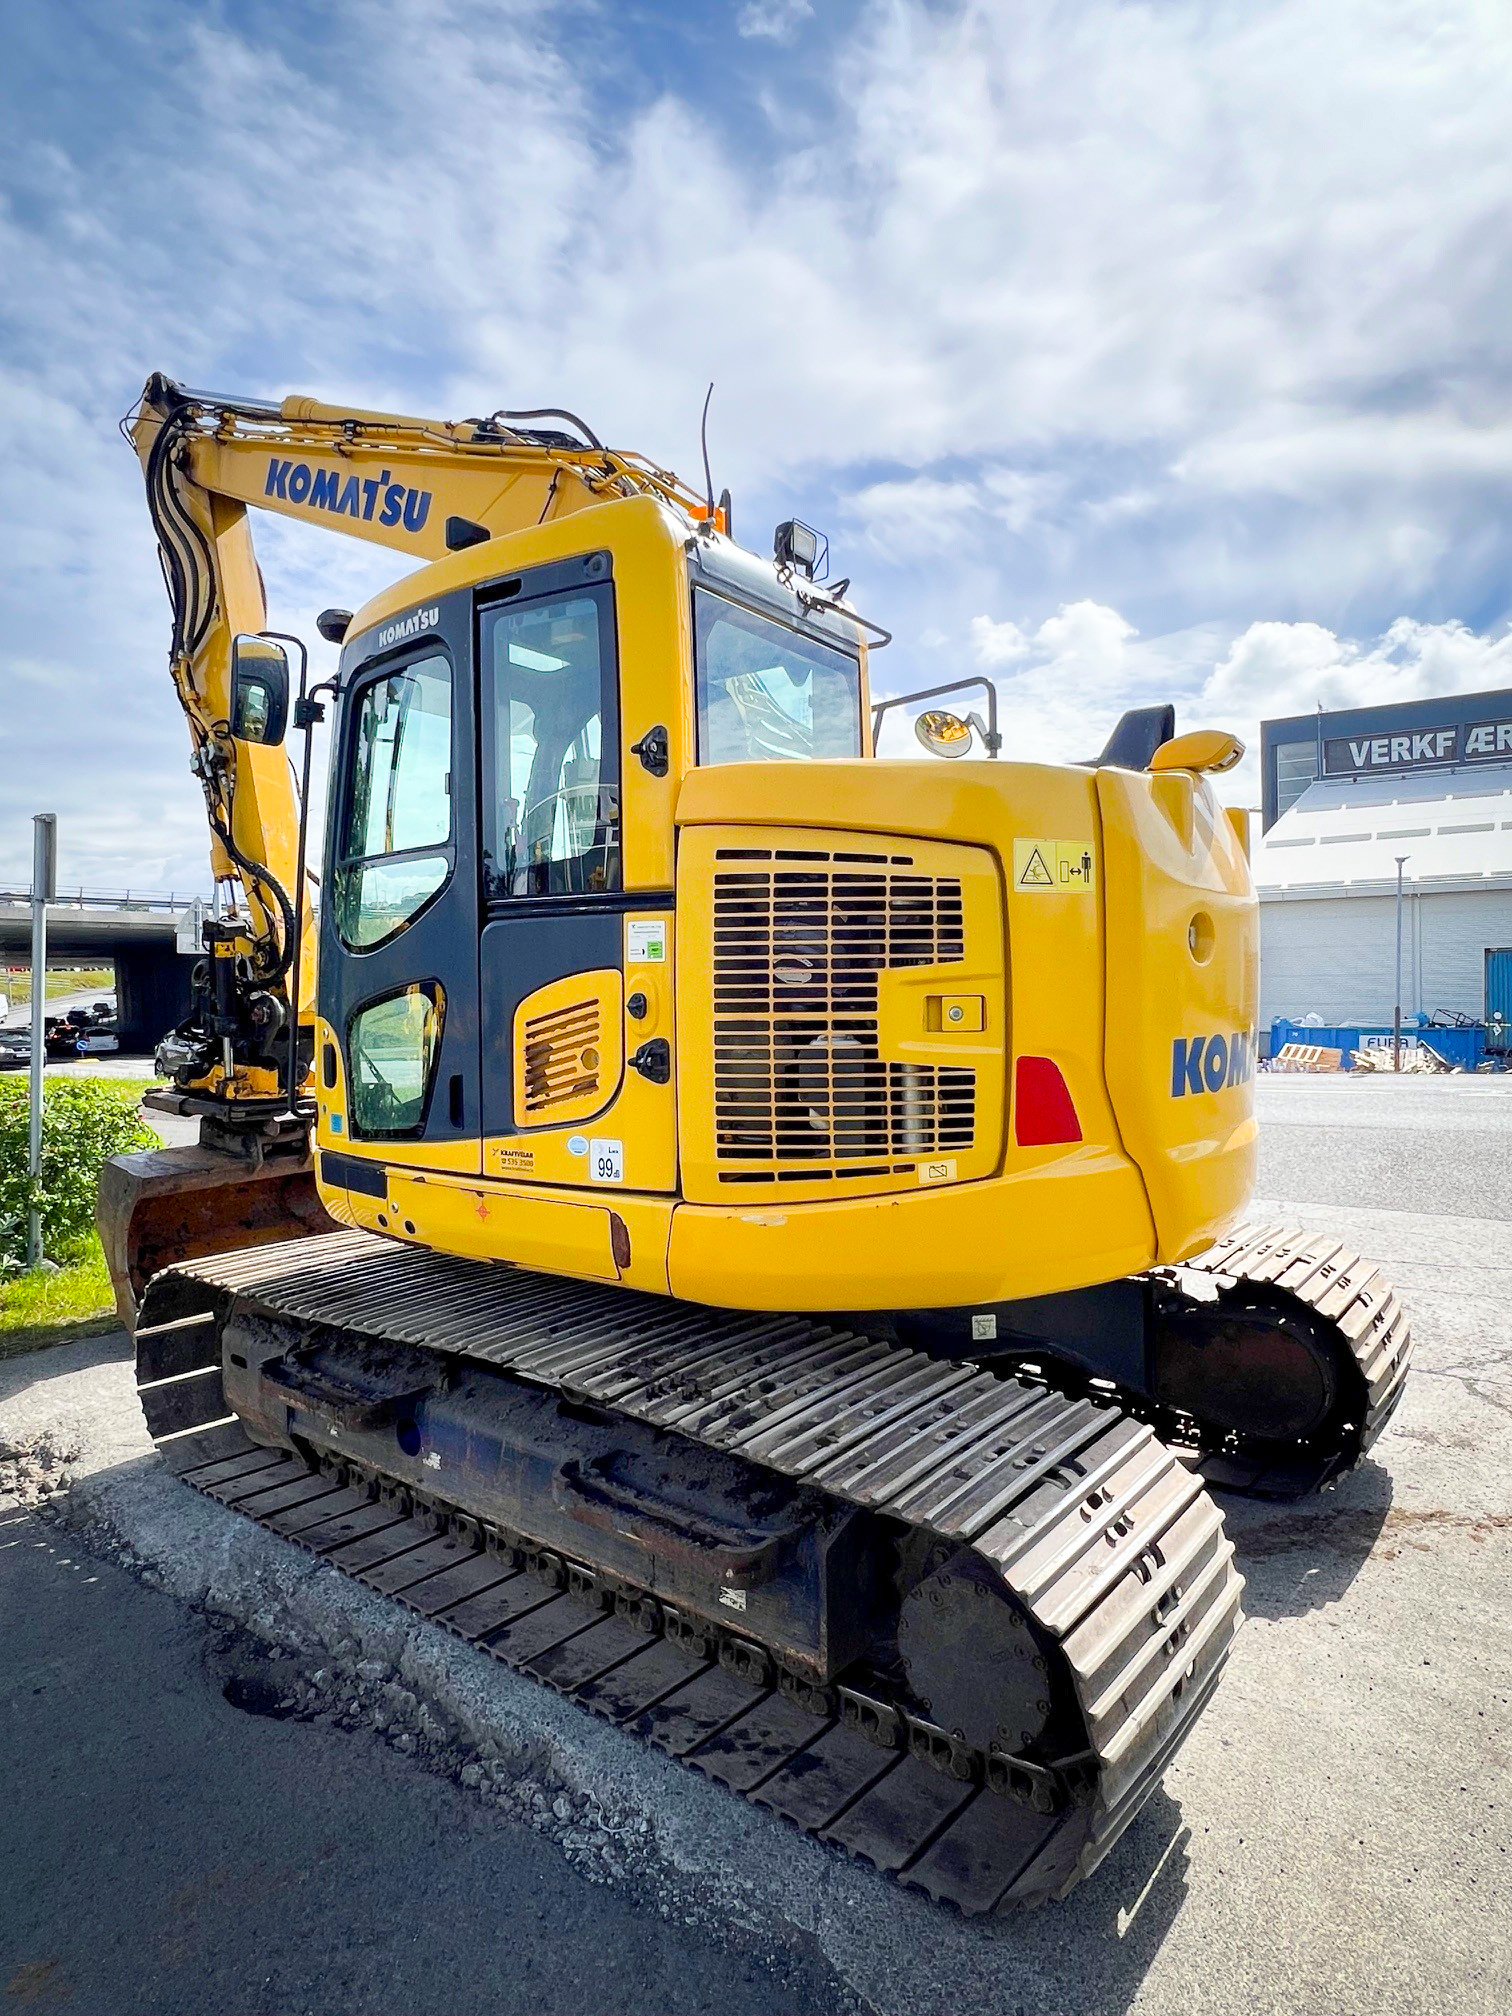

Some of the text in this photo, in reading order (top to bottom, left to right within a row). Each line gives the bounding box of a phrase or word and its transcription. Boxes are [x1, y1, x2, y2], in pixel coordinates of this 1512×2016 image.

[265, 458, 432, 533] KOMATSU
[379, 606, 439, 648] KOMATSU
[598, 1157, 613, 1178] 99
